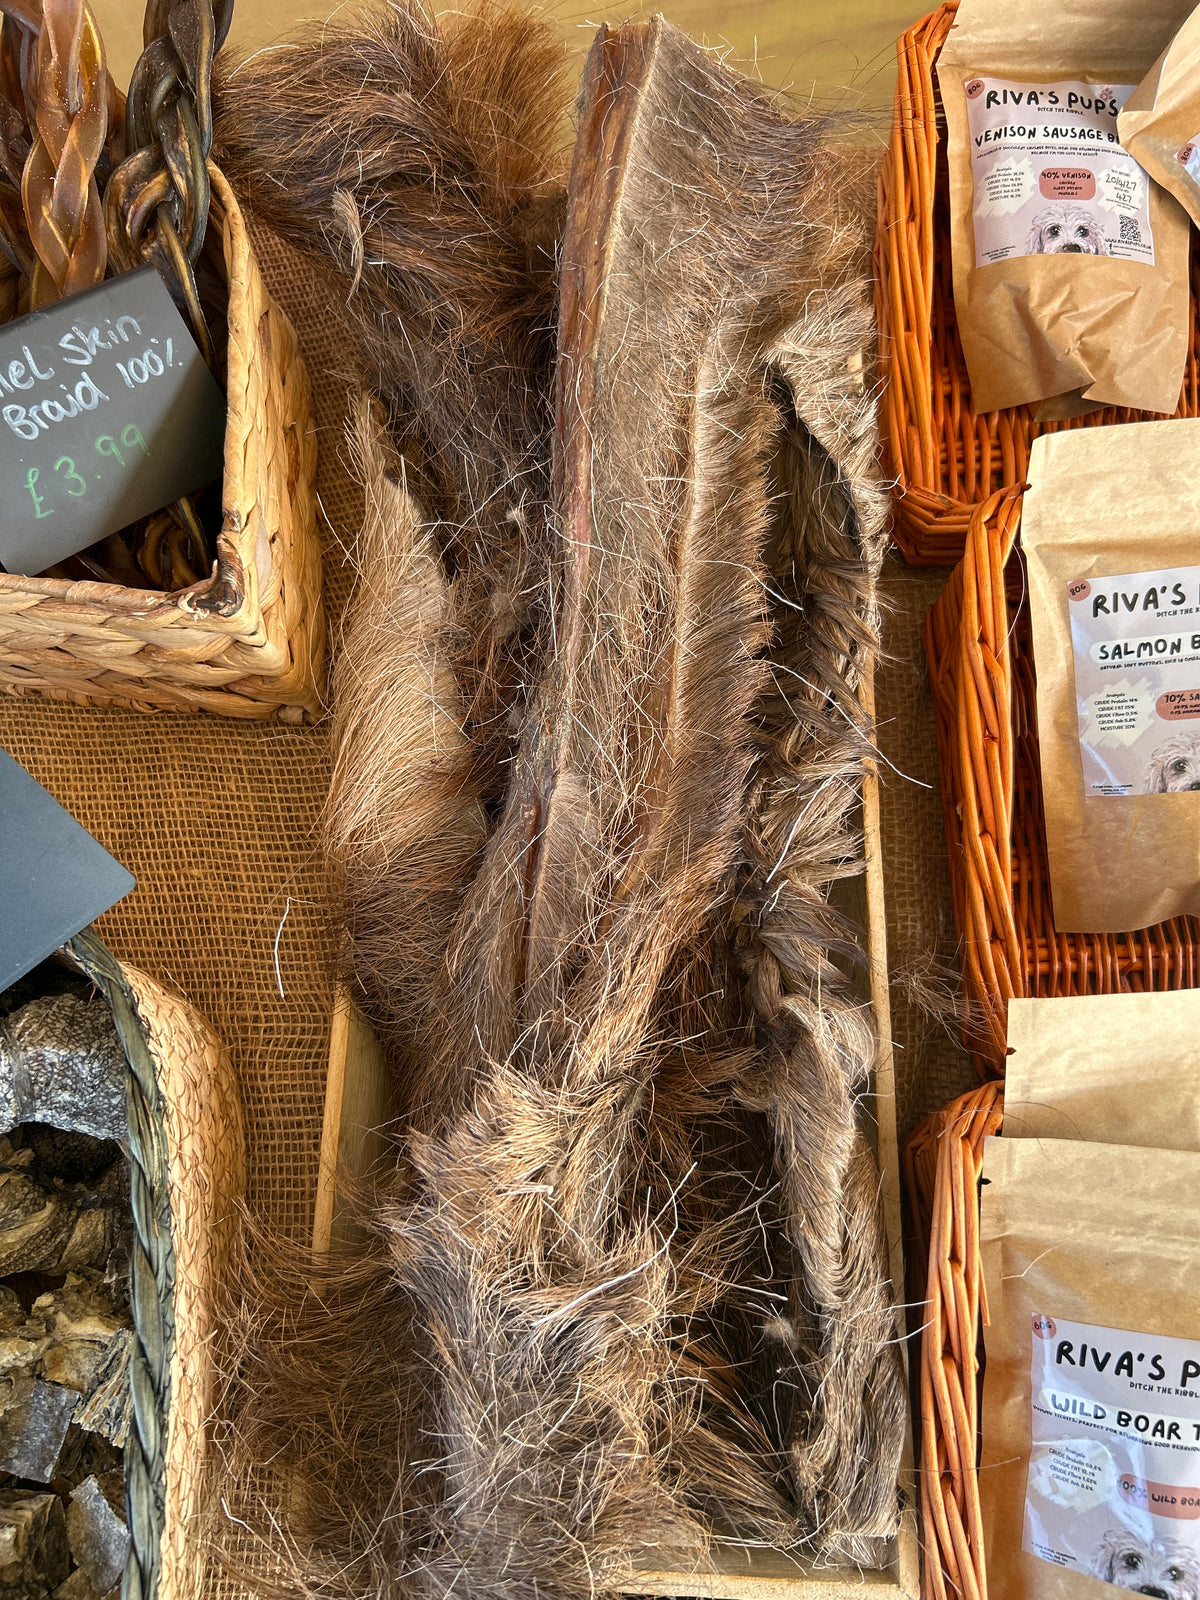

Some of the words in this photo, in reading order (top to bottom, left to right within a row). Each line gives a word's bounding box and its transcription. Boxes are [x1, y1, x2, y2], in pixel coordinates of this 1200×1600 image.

[986, 89, 1059, 109] RIVA'S
[1067, 91, 1119, 117] PUPS
[975, 126, 1036, 147] VENISON
[1042, 126, 1103, 140] SAUSAGE
[1041, 171, 1059, 180] 40%
[1061, 172, 1091, 180] VENISON
[2, 371, 110, 441] Braid
[116, 337, 183, 389] 100%
[24, 423, 151, 519] £3.99
[1069, 583, 1086, 596] 80G
[1092, 583, 1186, 618] RIVA'S
[1157, 609, 1177, 618] DITCH
[1180, 607, 1193, 615] THE
[1098, 638, 1182, 660] SALMON
[1034, 1321, 1052, 1330] 60G
[1055, 1340, 1165, 1381] RIVA'S
[1129, 1381, 1154, 1392] DITCH
[1157, 1385, 1173, 1395] THE
[1051, 1394, 1107, 1420] WILD
[1117, 1410, 1182, 1441] BOAR
[1078, 1419, 1104, 1430] PERFECT
[1105, 1427, 1118, 1435] FOR
[1151, 1493, 1177, 1505] WILD
